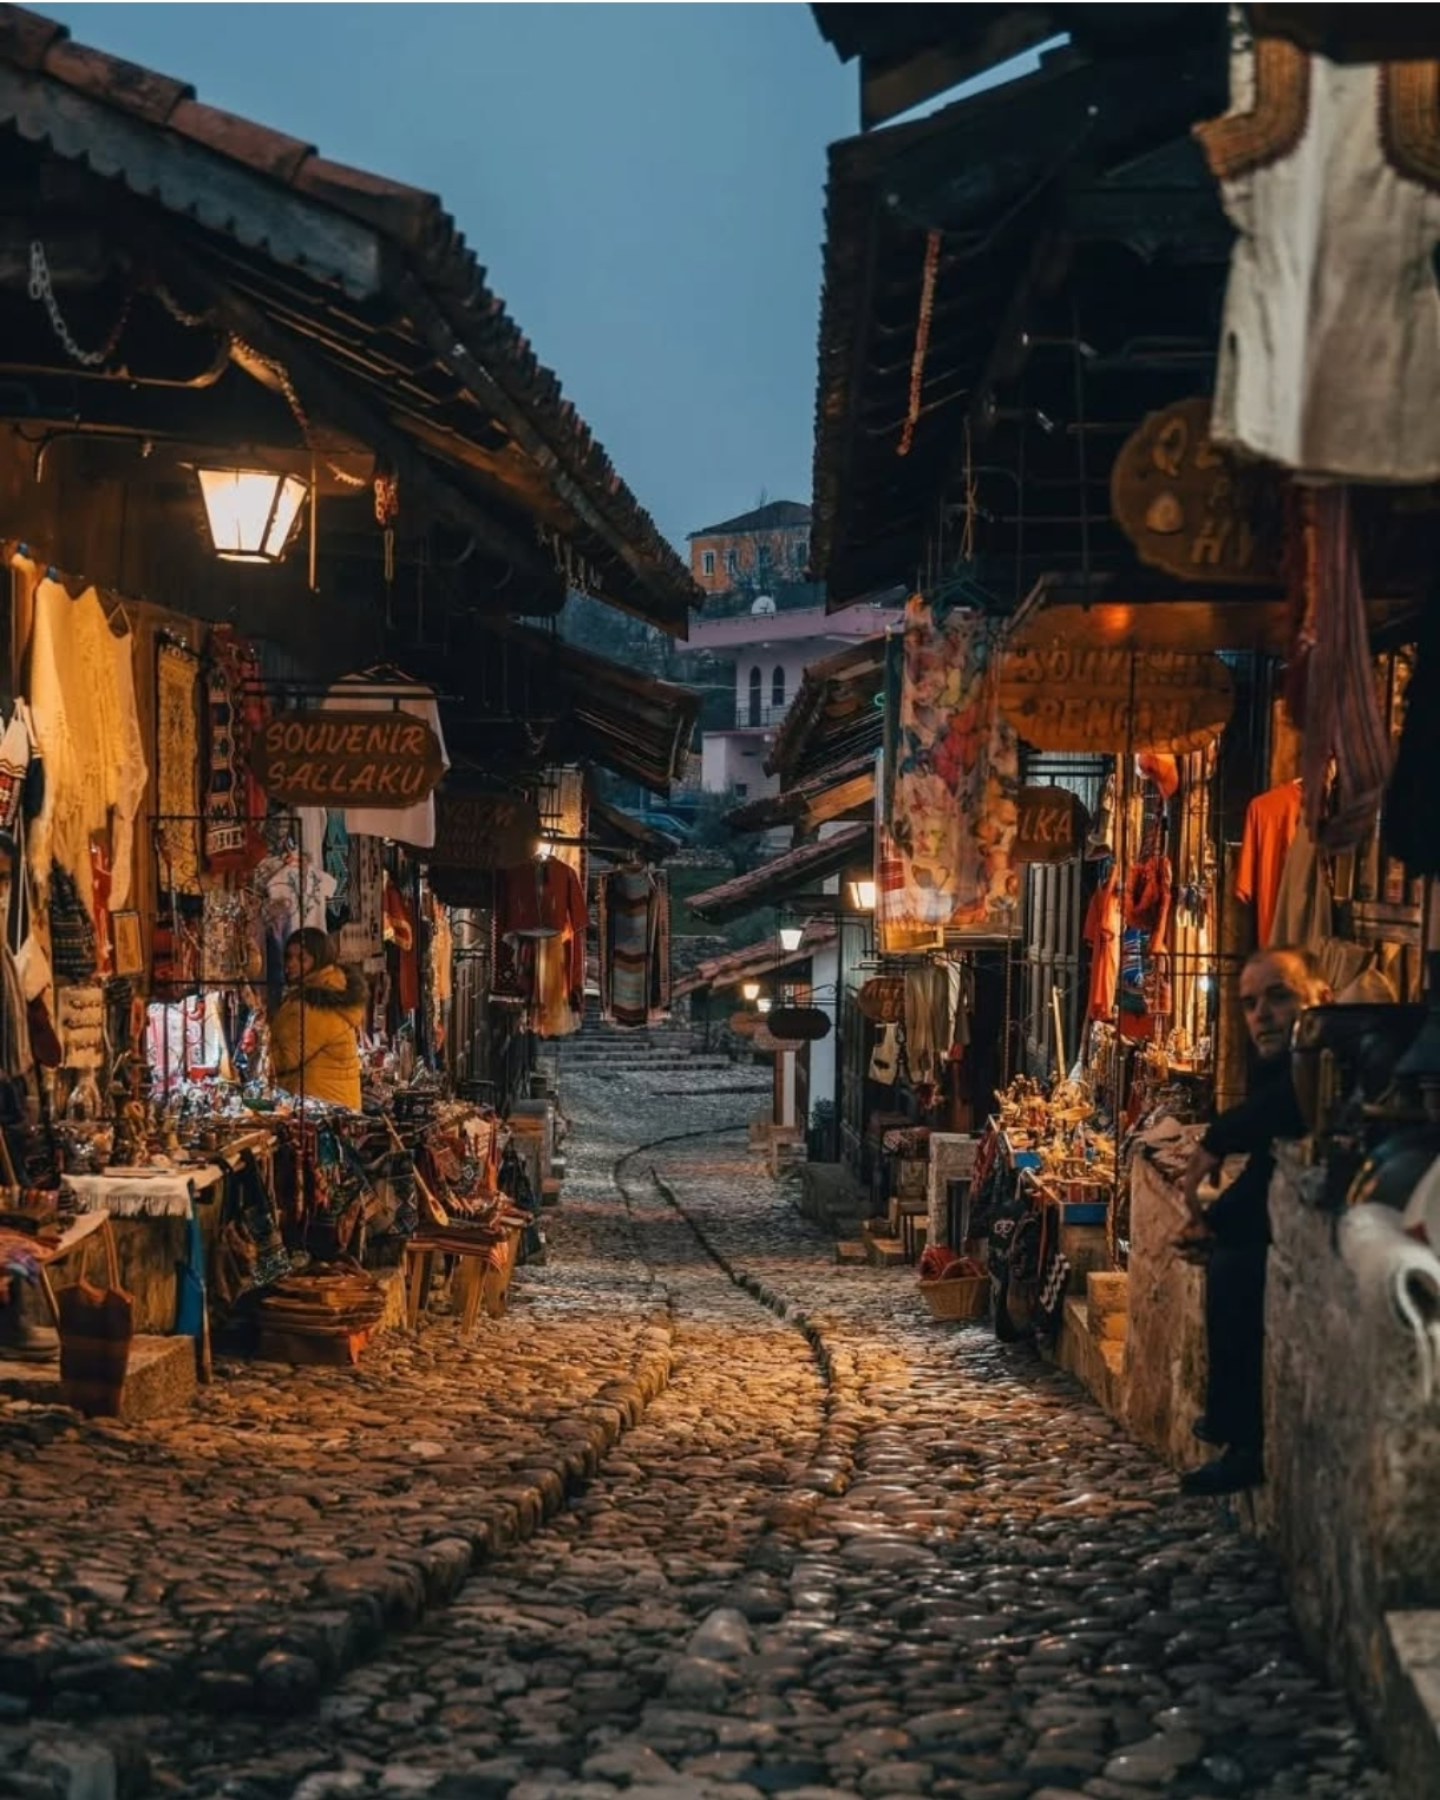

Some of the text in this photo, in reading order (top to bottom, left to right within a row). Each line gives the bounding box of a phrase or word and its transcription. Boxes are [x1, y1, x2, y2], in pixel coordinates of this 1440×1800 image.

[266, 721, 426, 755] SOUVENIR
[267, 761, 426, 795] SALLAKU
[1018, 807, 1073, 843] LKA
